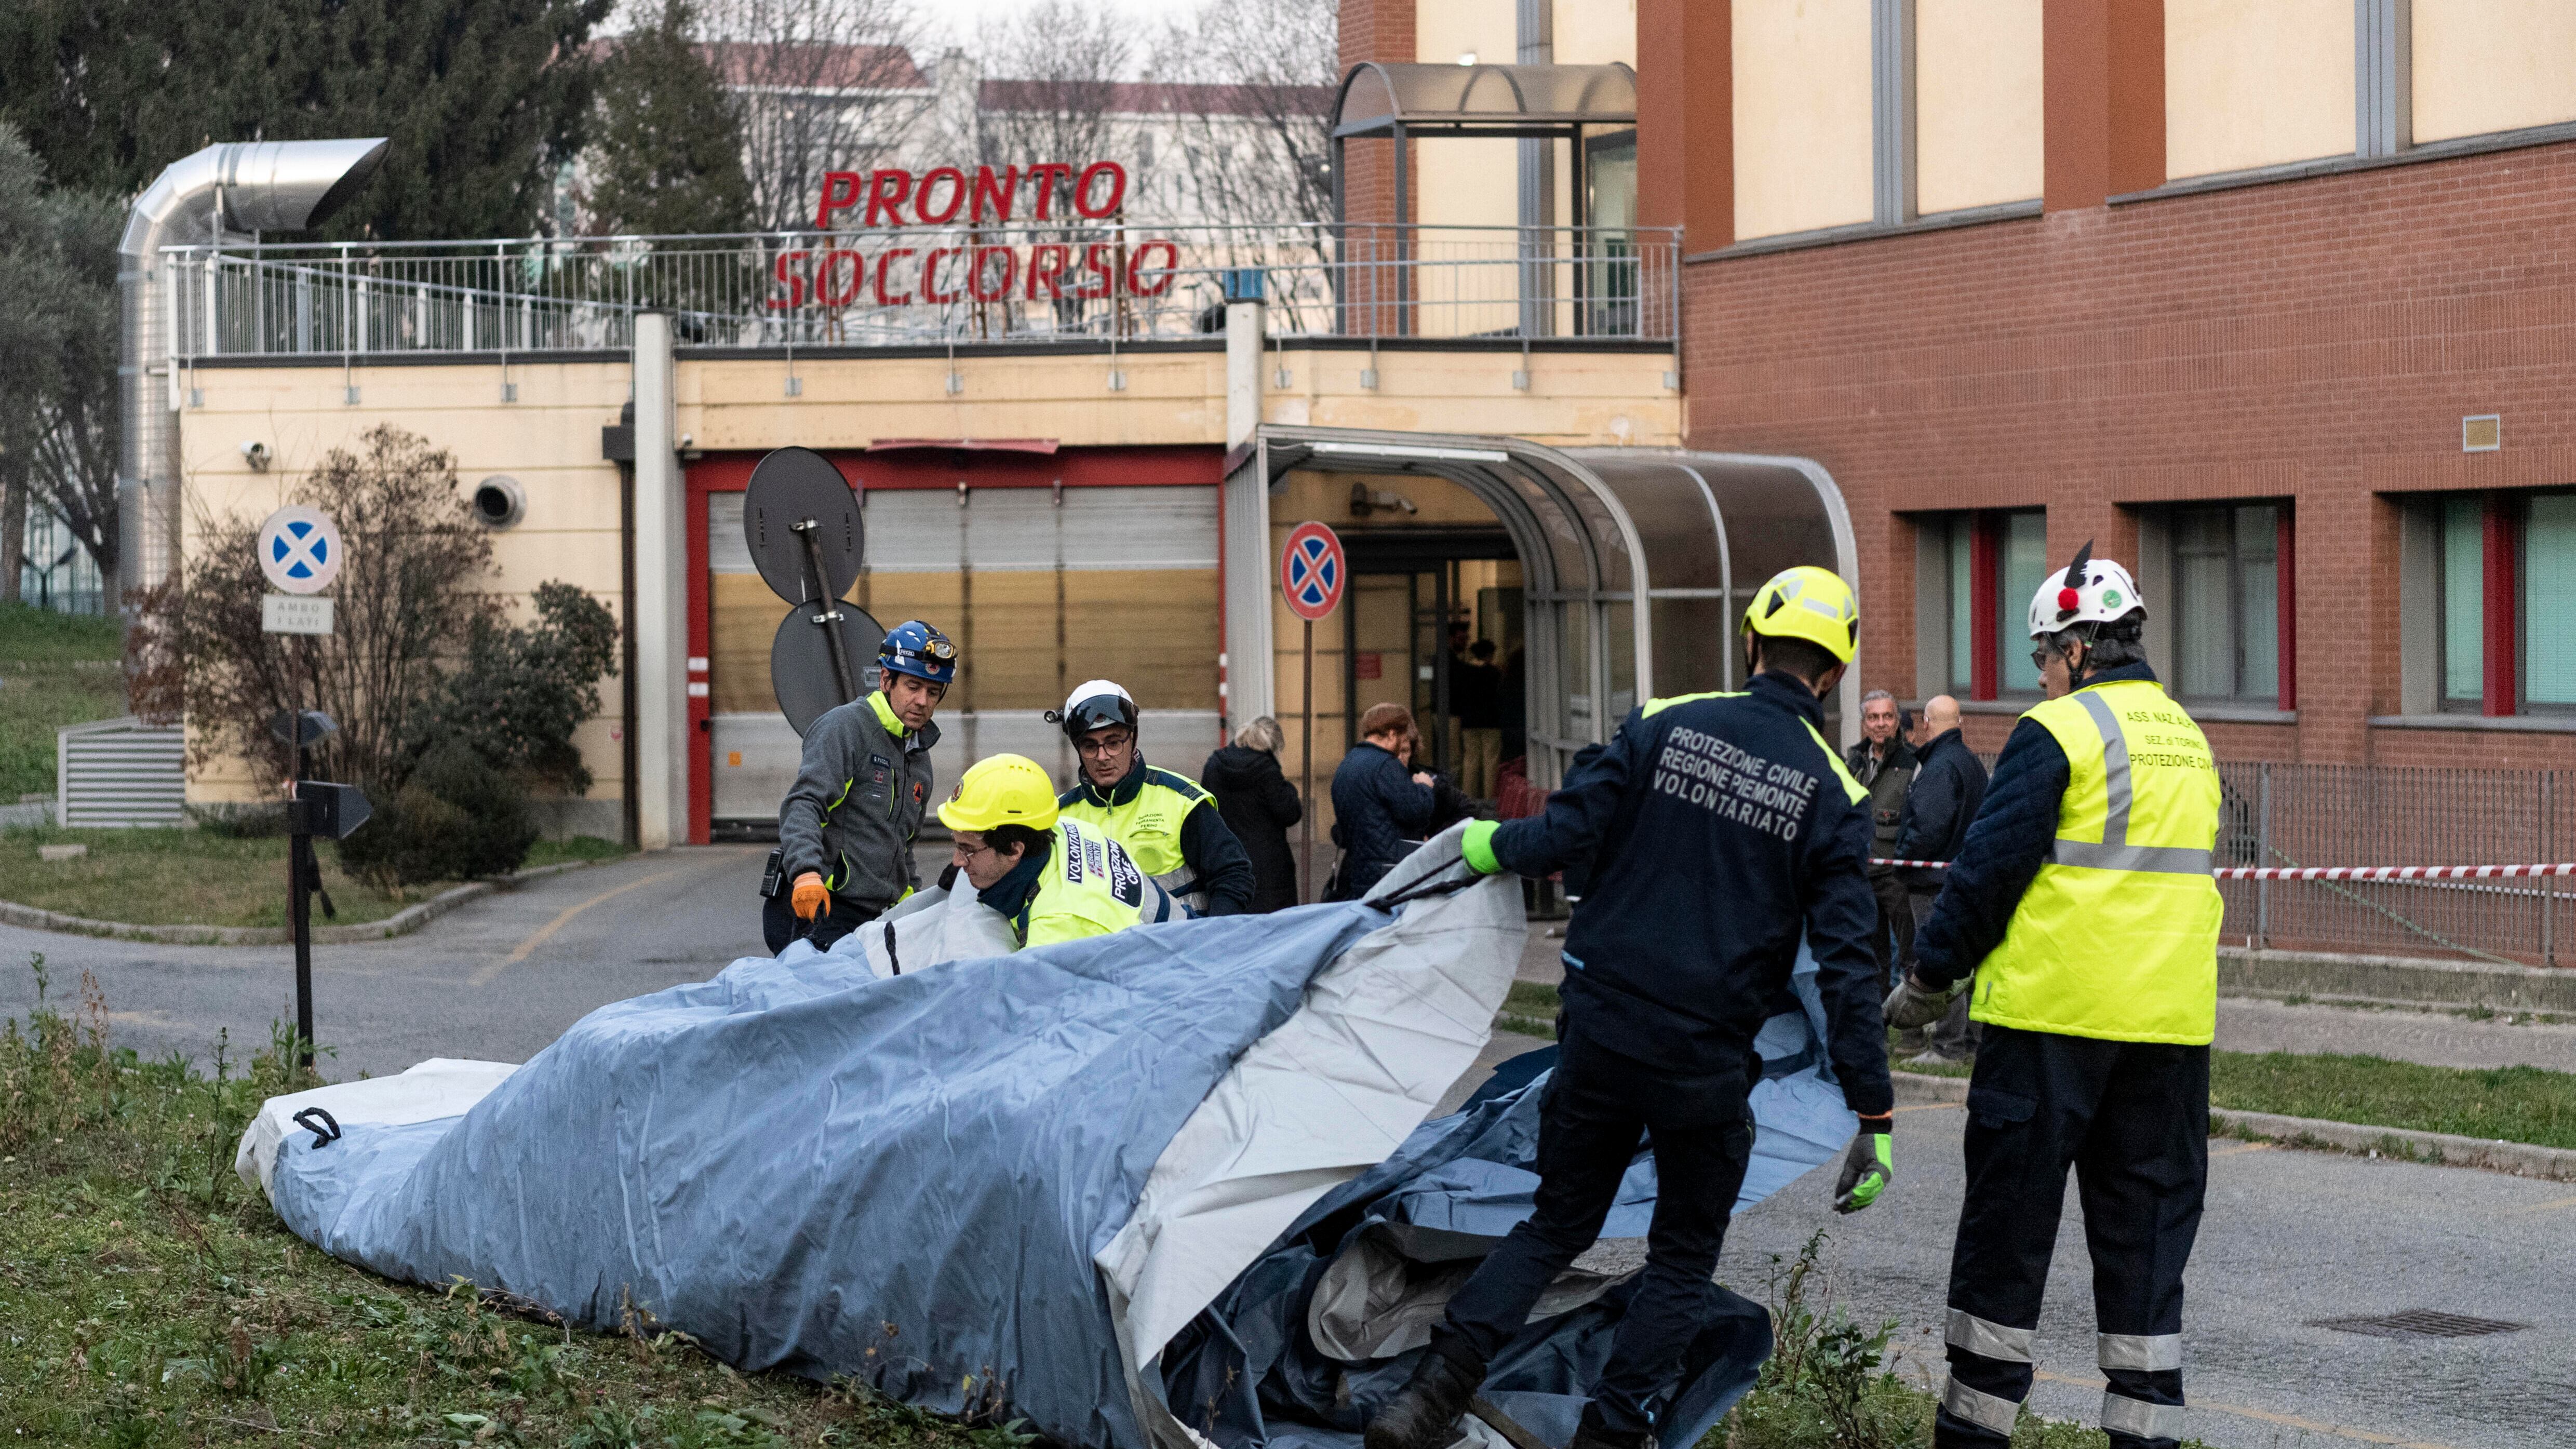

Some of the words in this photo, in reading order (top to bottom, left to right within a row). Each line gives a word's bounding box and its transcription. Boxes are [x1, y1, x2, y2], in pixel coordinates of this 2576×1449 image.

[815, 160, 1127, 229] PRONTO
[767, 238, 1179, 310] SOCCORSO
[1659, 746, 1732, 789] REGIONE
[1729, 773, 1808, 820] PIEMONTE
[1668, 727, 1767, 777] PROTEZIONE
[1766, 763, 1819, 798] CIVILE
[2129, 754, 2196, 768] PROTEZIONE
[1653, 769, 1798, 841] VOLONTARIATO
[1065, 823, 1081, 880] VOLONTARIO
[1108, 838, 1126, 900] PROTEZIONE
[1121, 857, 1139, 885] CIVILE
